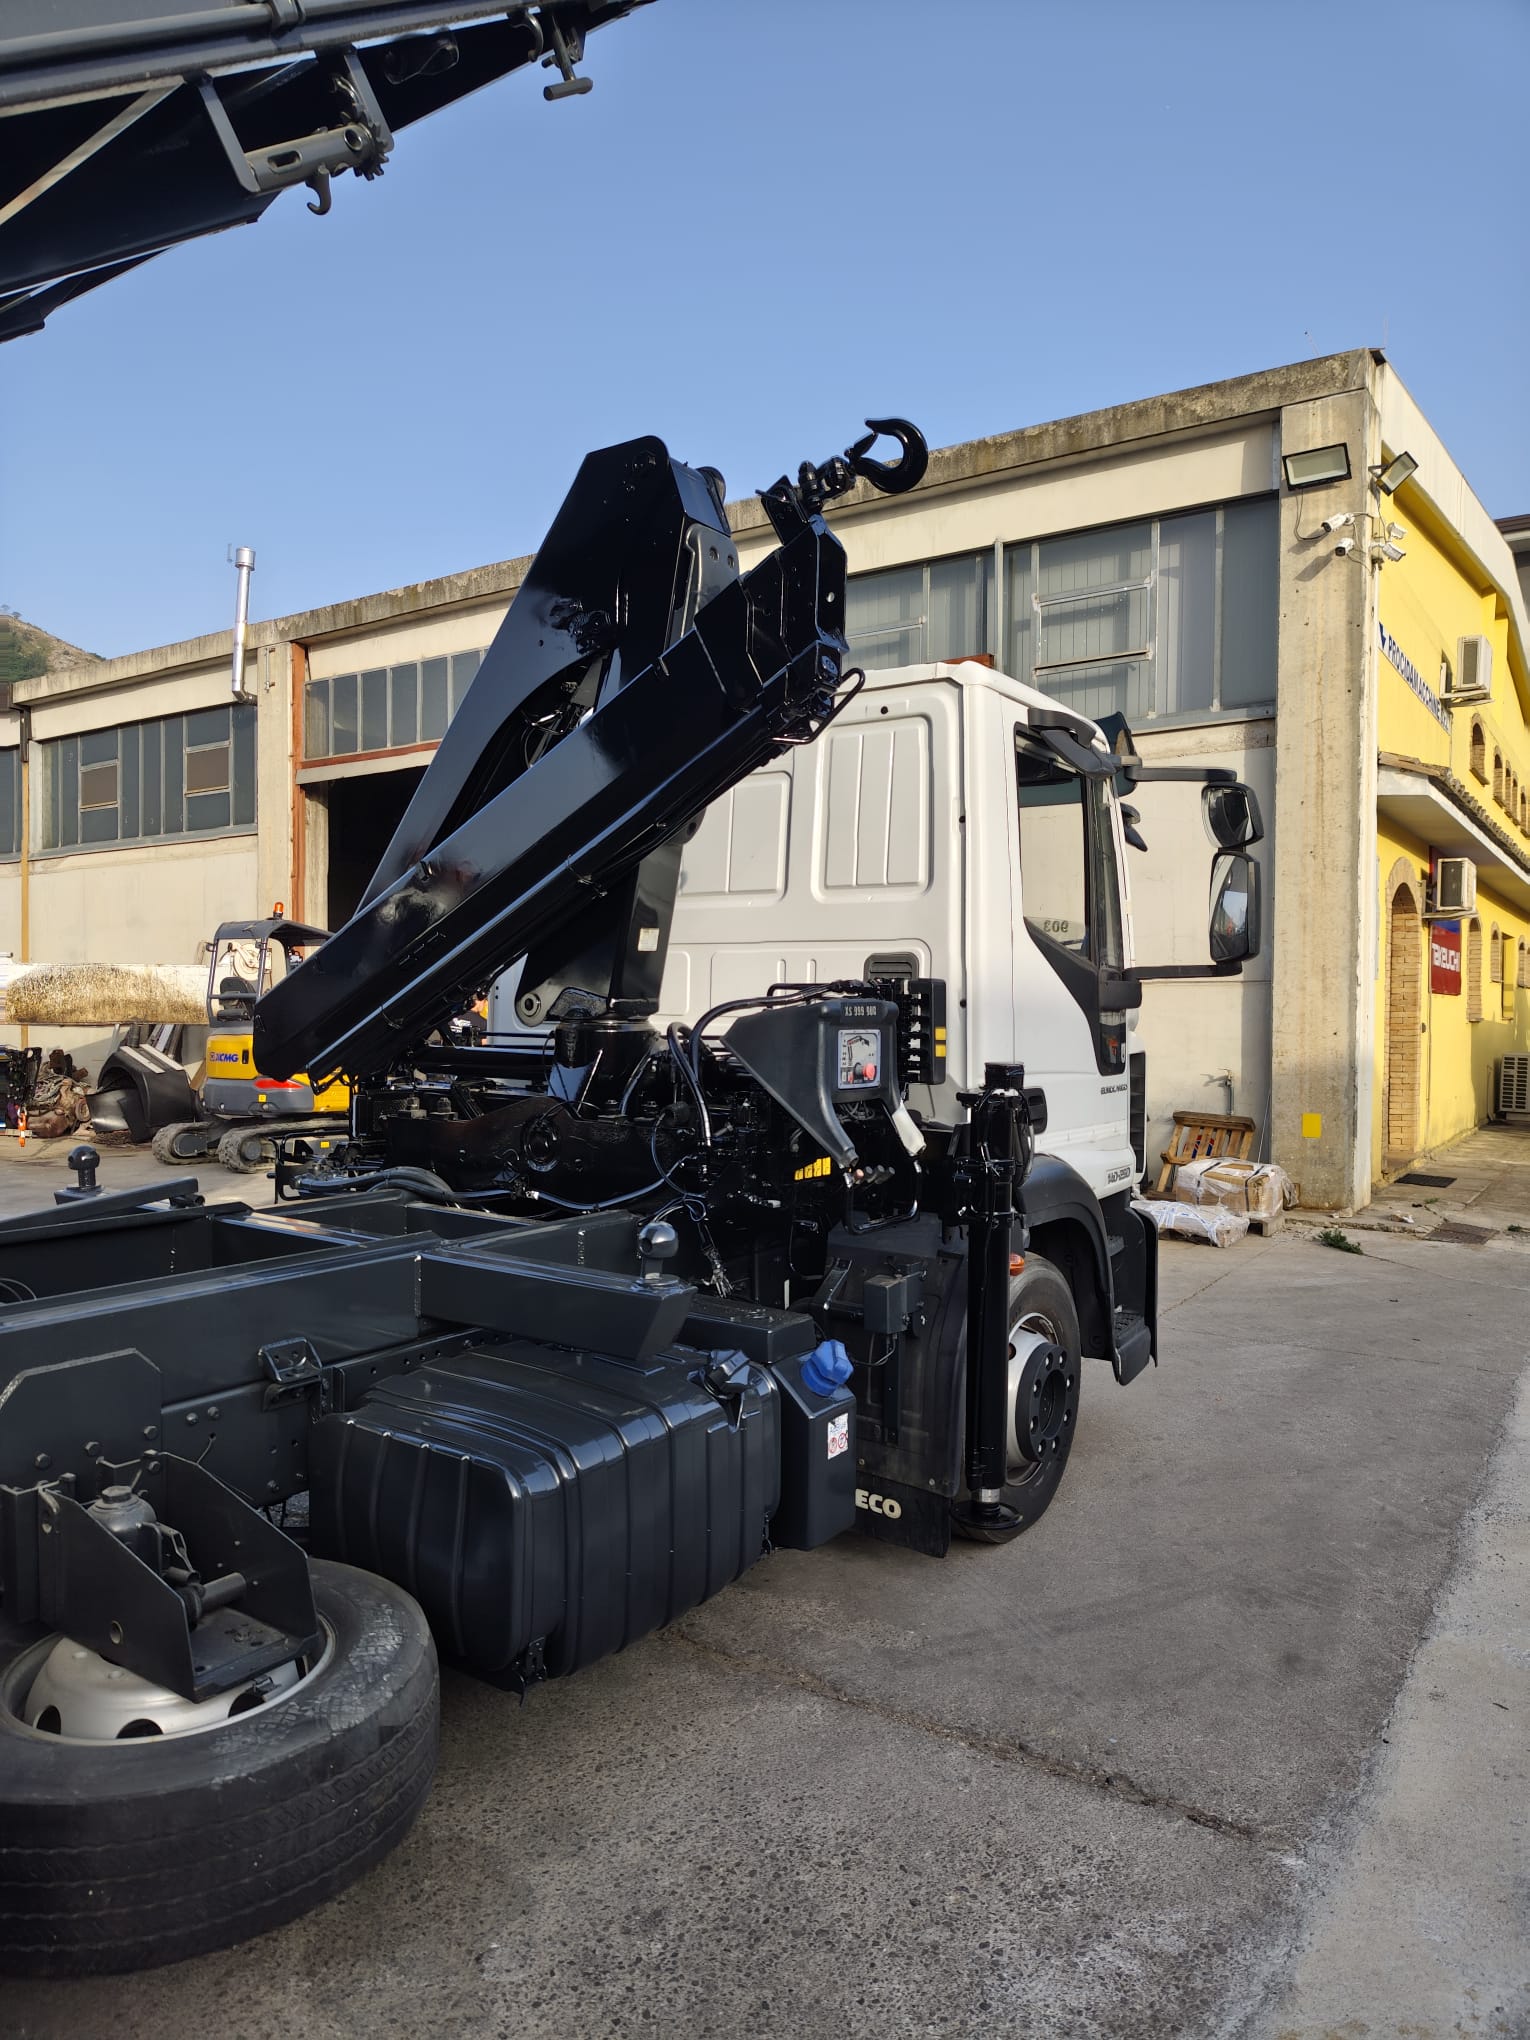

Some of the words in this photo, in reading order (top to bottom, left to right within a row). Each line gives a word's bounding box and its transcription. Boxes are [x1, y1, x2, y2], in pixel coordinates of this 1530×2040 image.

[1388, 633, 1413, 684] PROCIDA
[1431, 942, 1461, 973] TAKEUCHI
[215, 1052, 239, 1063] XCMG
[855, 1488, 902, 1519] ECO
